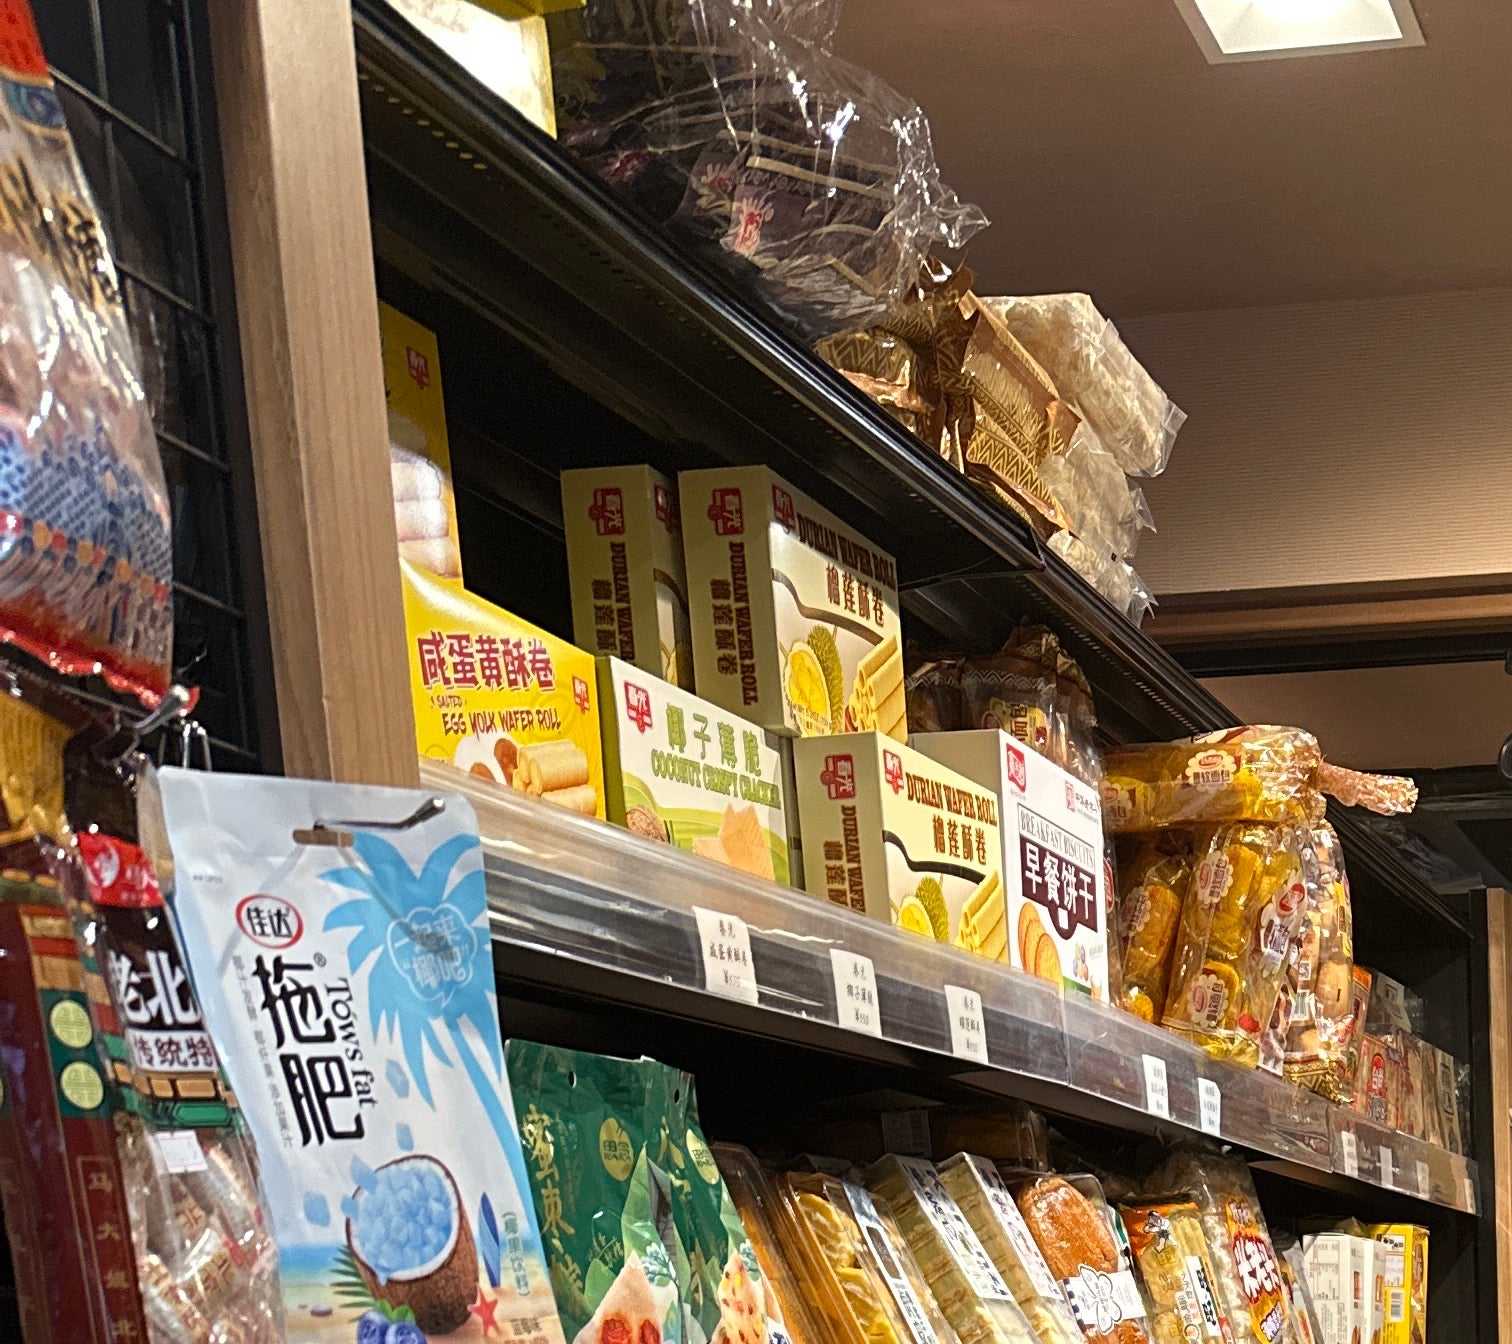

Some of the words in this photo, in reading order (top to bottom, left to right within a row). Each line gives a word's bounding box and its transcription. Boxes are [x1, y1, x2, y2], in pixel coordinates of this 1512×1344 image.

[610, 541, 629, 595] DURIAN
[728, 541, 748, 595] DURIAN
[798, 512, 837, 560] DURIAN
[836, 536, 872, 578] WAFER
[872, 552, 897, 591] ROLL
[590, 578, 618, 657] 榴莲酥
[826, 563, 886, 628] 榴莲酥卷
[709, 578, 739, 676] 榴莲酥卷
[733, 597, 752, 654] WAFER
[417, 630, 556, 692] 咸蛋黄酥卷
[738, 656, 758, 706] ROLL
[443, 710, 467, 736] EGG
[470, 710, 496, 741] YOLK
[498, 709, 535, 734] WAFER
[535, 708, 562, 732] ROLL
[665, 703, 762, 777] 椰子薄脆
[651, 747, 701, 789] COCONUT
[906, 772, 944, 810] DURIAN
[942, 782, 977, 818] WAFER
[974, 793, 998, 826] ROLL
[840, 805, 859, 852] DURIAN
[932, 814, 988, 866] 榴莲酥卷
[1017, 806, 1065, 850] BREAKFAST
[1064, 832, 1095, 870] BISCUITS
[1022, 840, 1096, 921] 早餐饼干
[246, 905, 293, 938] 佳达
